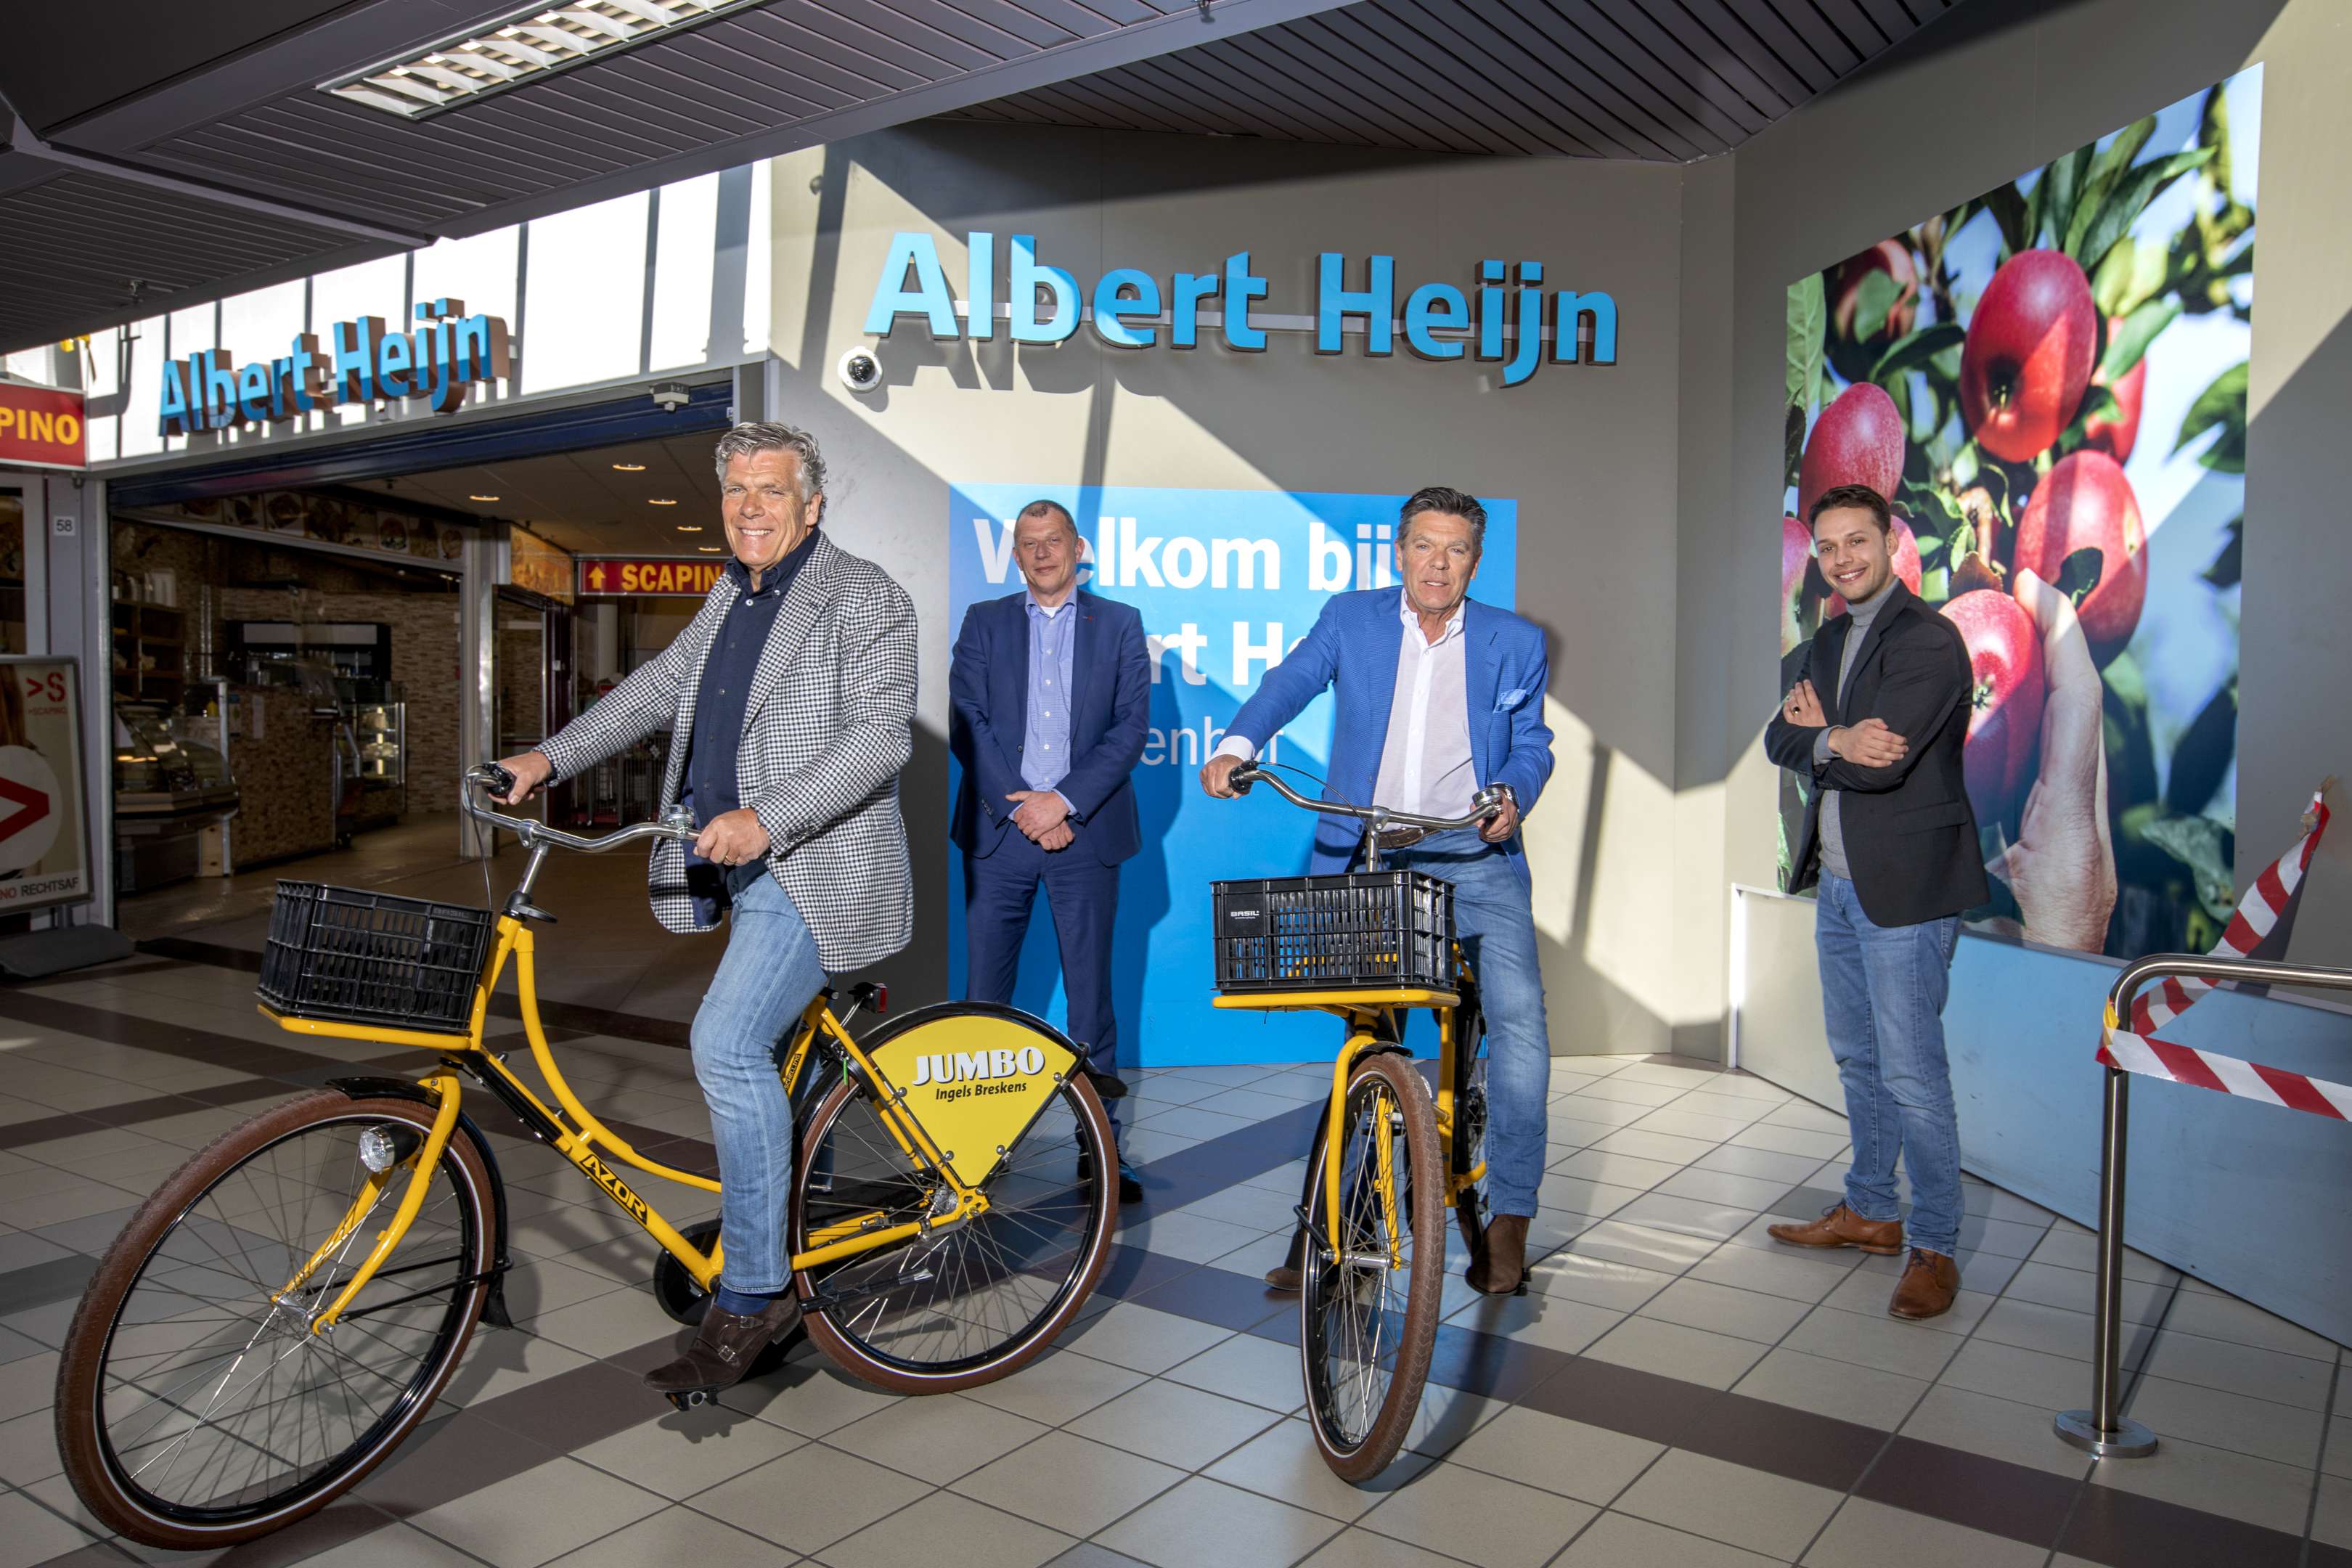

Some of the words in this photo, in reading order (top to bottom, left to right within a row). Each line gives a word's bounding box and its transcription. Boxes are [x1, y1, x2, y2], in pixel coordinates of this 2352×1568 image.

[864, 231, 1267, 353] Albert
[1315, 253, 1617, 389] Heijn
[158, 333, 319, 437] Albert
[333, 298, 502, 413] Heijn
[0, 407, 80, 445] PINO
[57, 519, 73, 531] 58
[1308, 522, 1392, 592] bij
[621, 564, 721, 592] SCAPIN
[21, 876, 78, 897] RECHTSAF
[912, 1046, 1045, 1086] JUMBO
[936, 1085, 971, 1103] Ingels
[975, 1081, 1027, 1097] Breskens
[581, 1154, 647, 1221] AZOR
